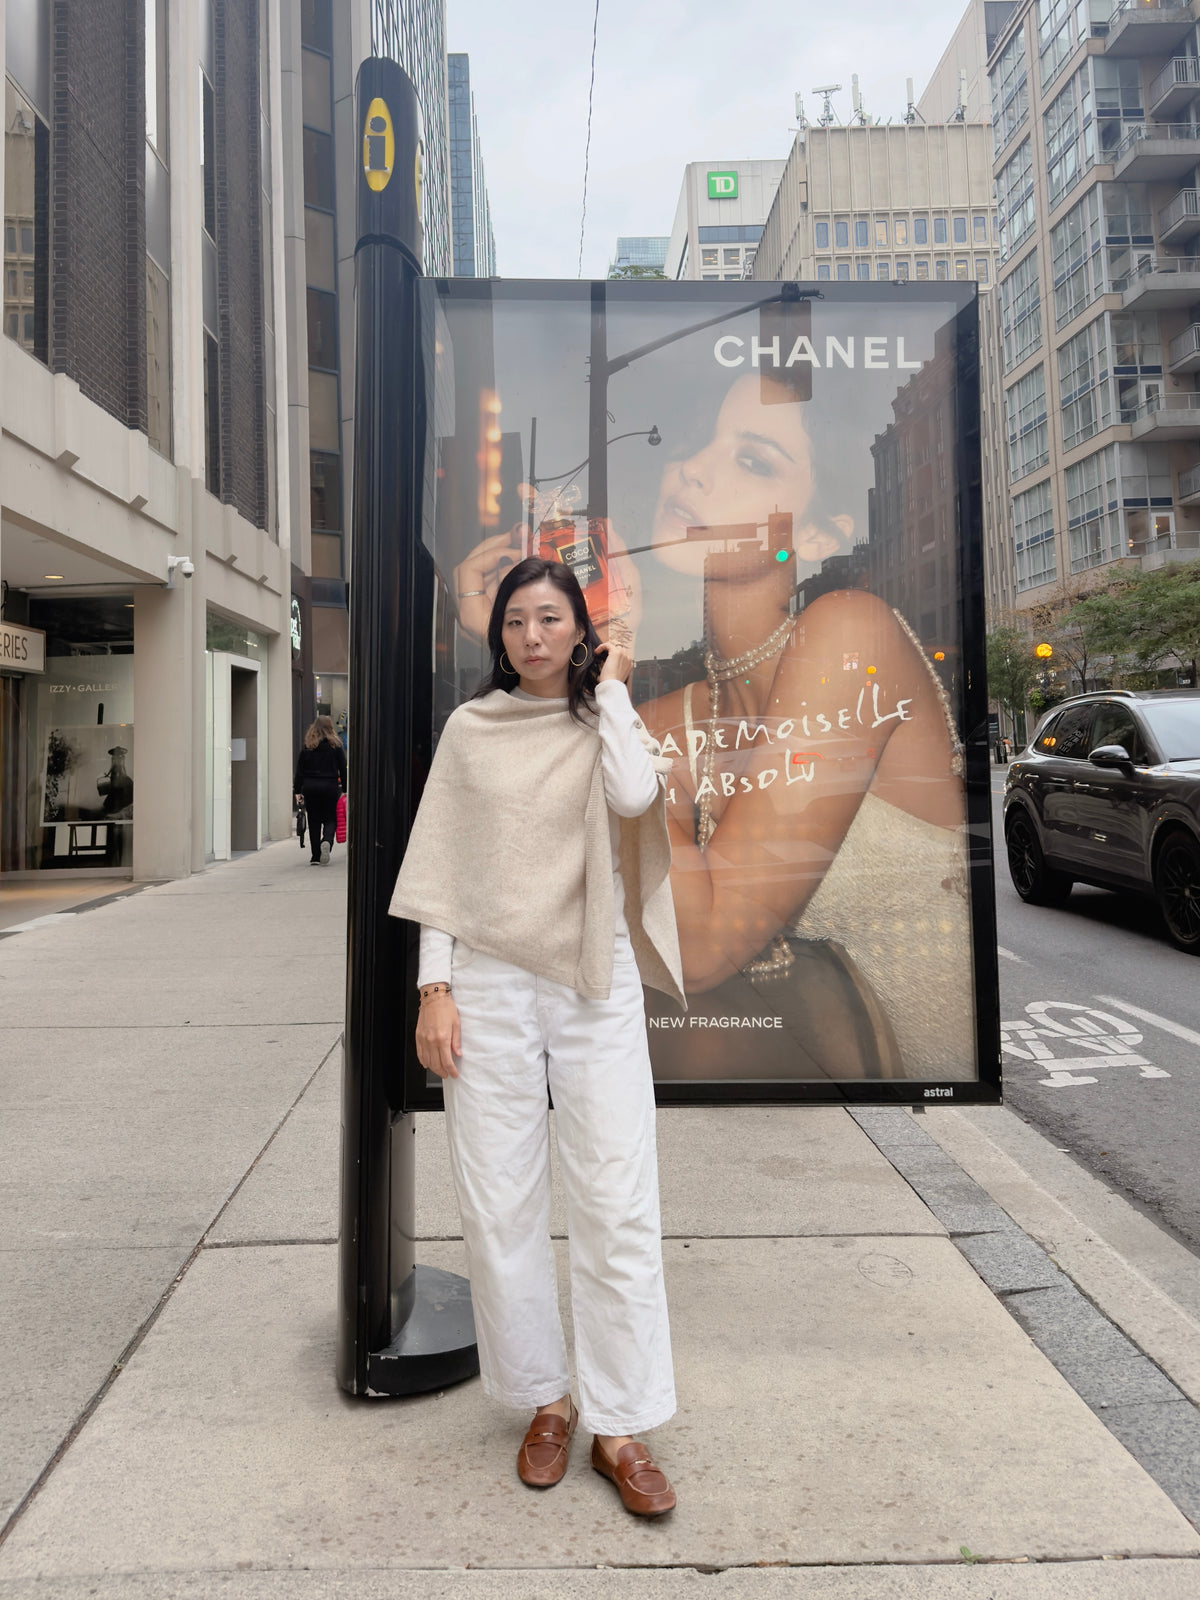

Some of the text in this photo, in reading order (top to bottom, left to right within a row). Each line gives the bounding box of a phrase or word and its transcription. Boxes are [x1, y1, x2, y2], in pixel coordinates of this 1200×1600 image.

[711, 177, 734, 193] TD
[713, 335, 922, 369] CHANEL
[566, 547, 589, 560] COCO
[574, 565, 596, 576] HANEL
[649, 1016, 783, 1029] NEW FRAGRANCE
[923, 1087, 954, 1097] astral
